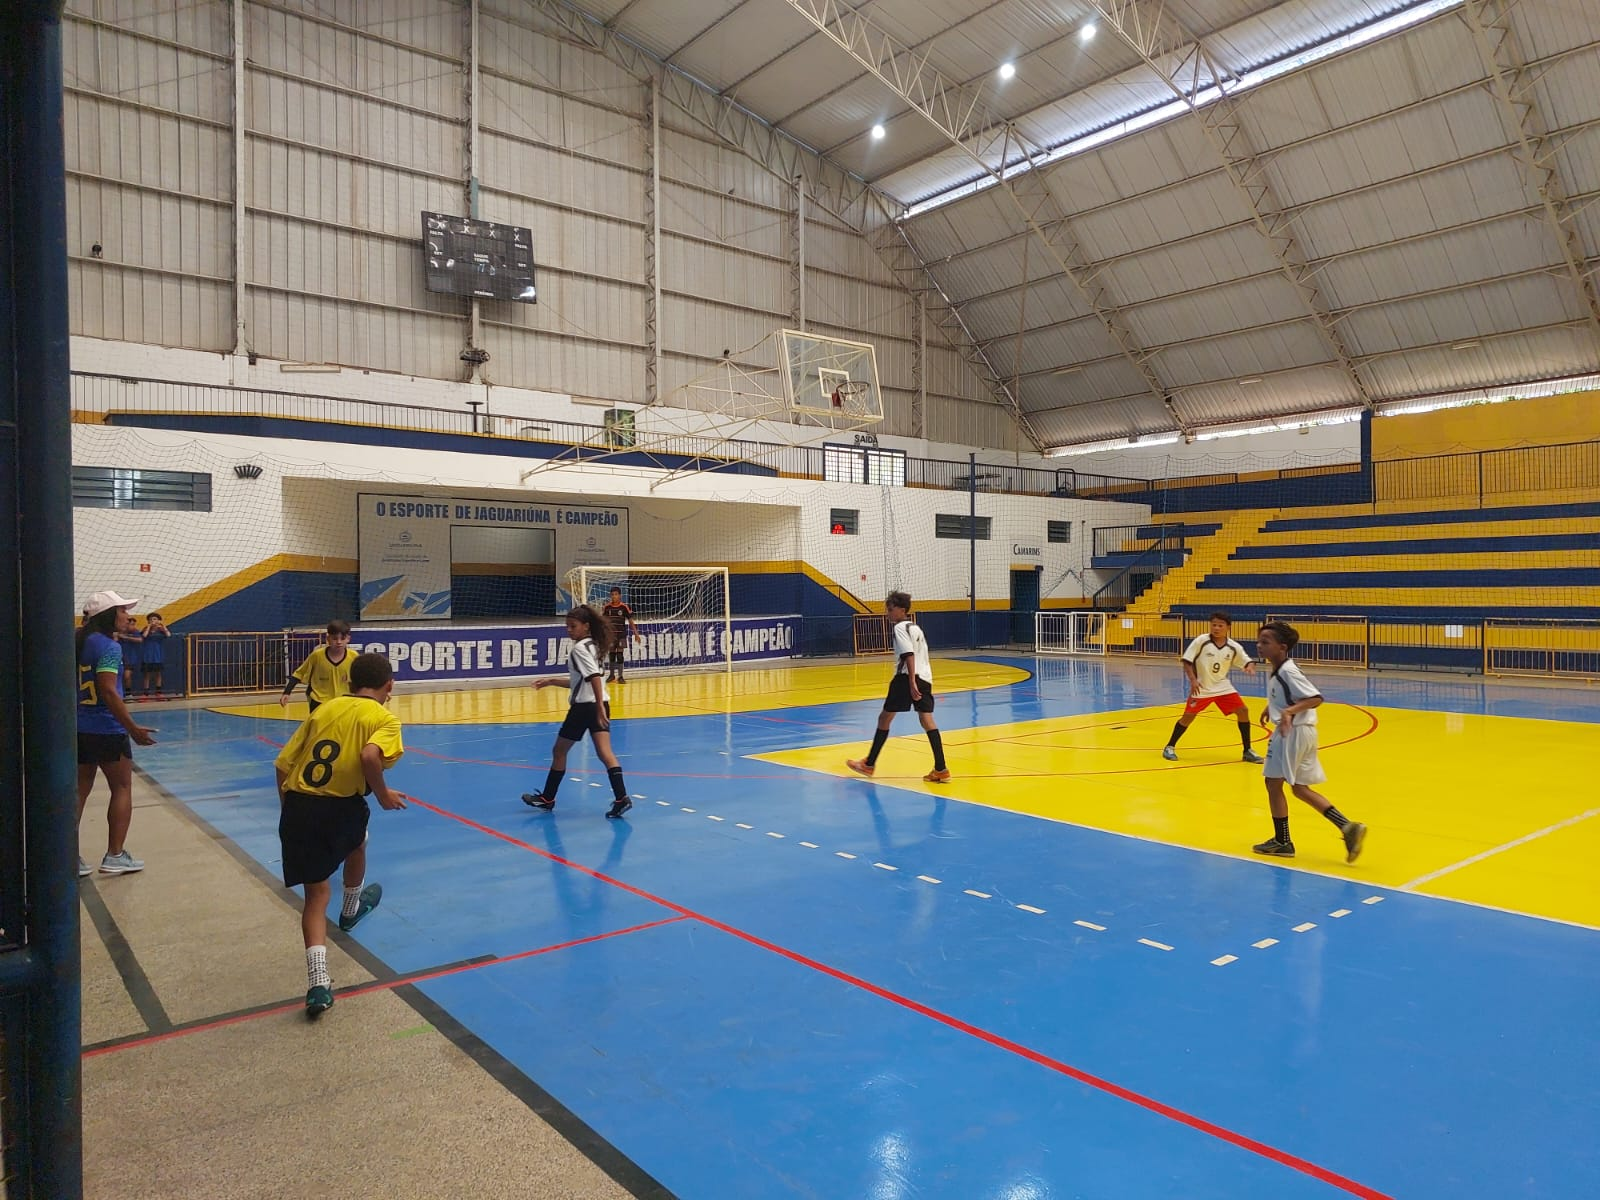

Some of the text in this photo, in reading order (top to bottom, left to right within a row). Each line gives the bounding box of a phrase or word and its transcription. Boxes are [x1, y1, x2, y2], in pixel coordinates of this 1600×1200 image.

[376, 502, 619, 526] O ESPORTE DE JAGUARIÚNA É CAMPEÃO
[347, 622, 793, 673] PORTE DE JARIÚNA É CAMPEÃO
[1212, 662, 1220, 673] 9
[303, 739, 340, 788] 8
